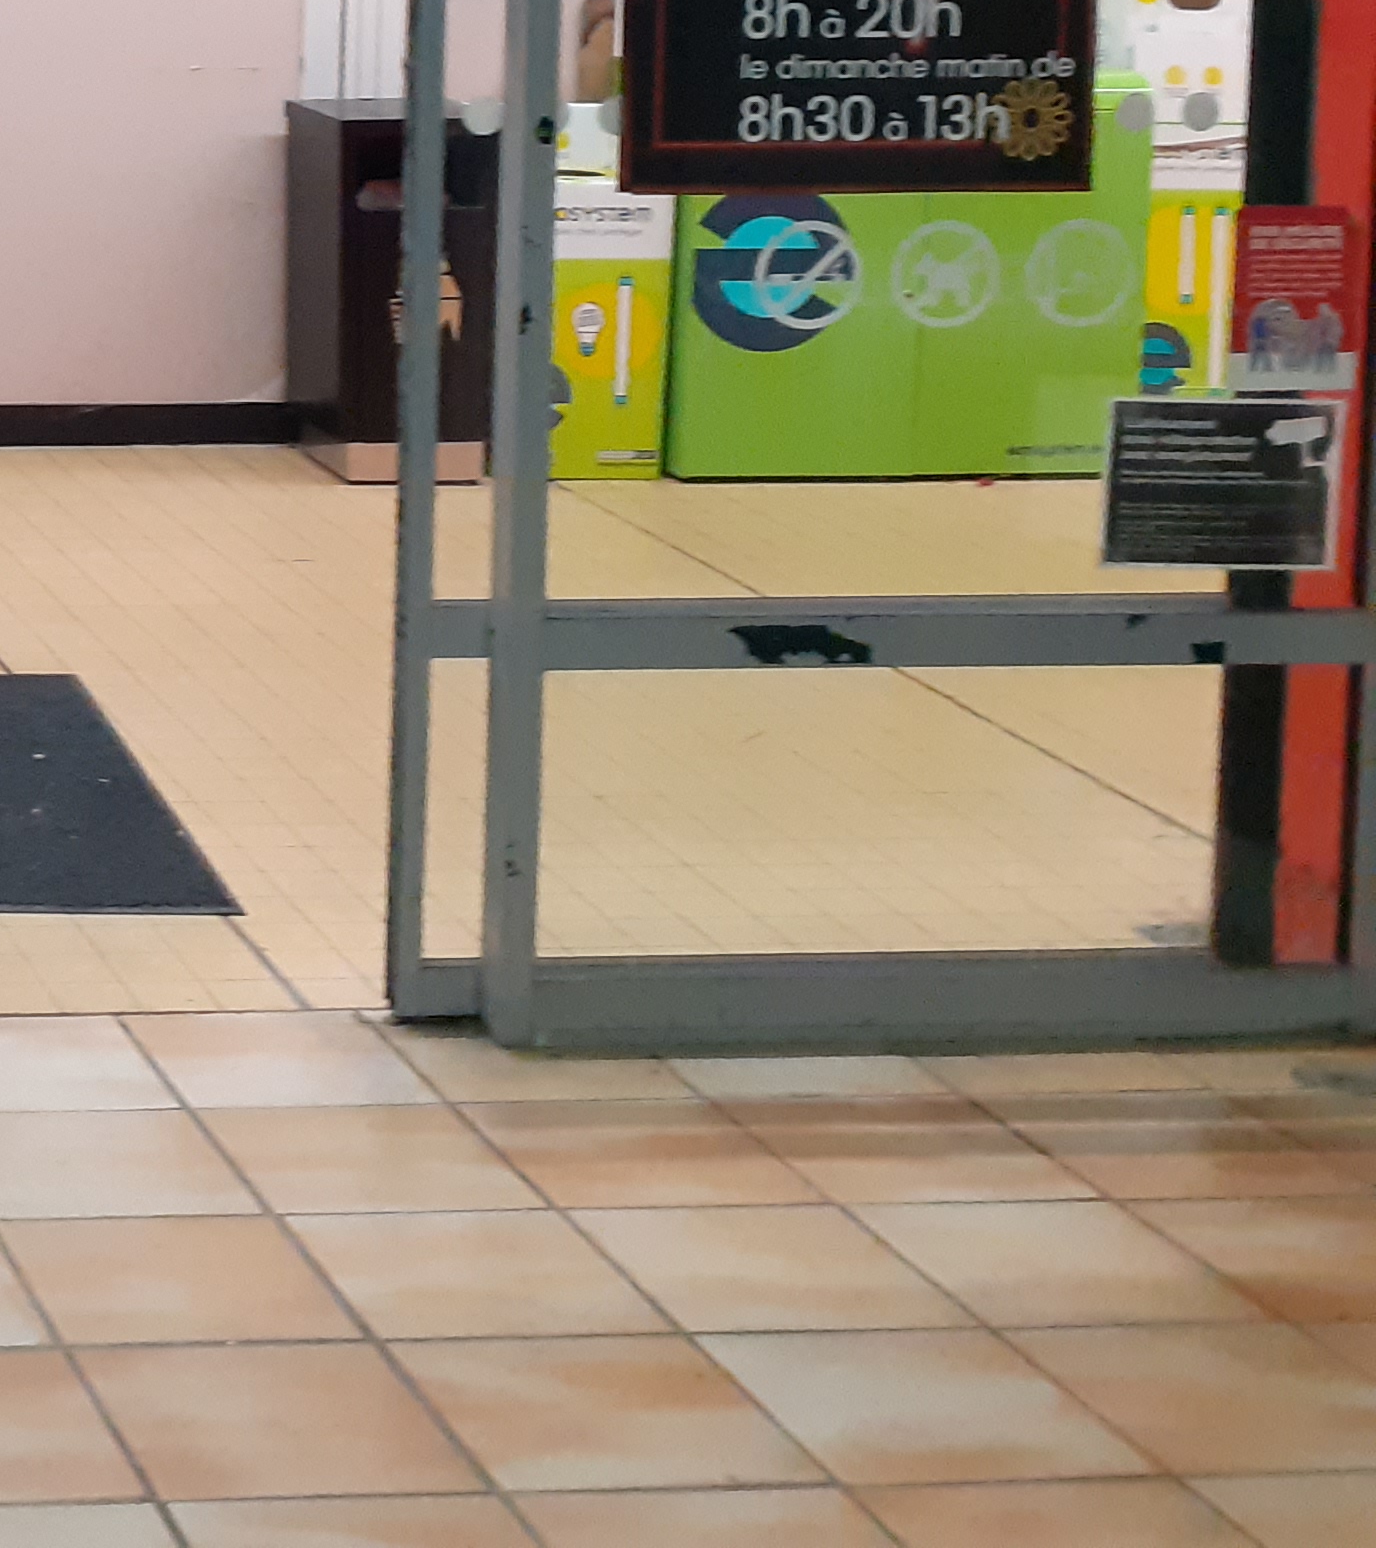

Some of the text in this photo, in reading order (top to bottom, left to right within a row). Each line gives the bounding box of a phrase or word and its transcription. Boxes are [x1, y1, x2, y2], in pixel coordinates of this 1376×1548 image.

[819, 8, 847, 39] à
[739, 53, 768, 80] le
[775, 53, 930, 80] dimanche
[1031, 52, 1078, 79] de
[737, 92, 1012, 143] 8h30 à 13h
